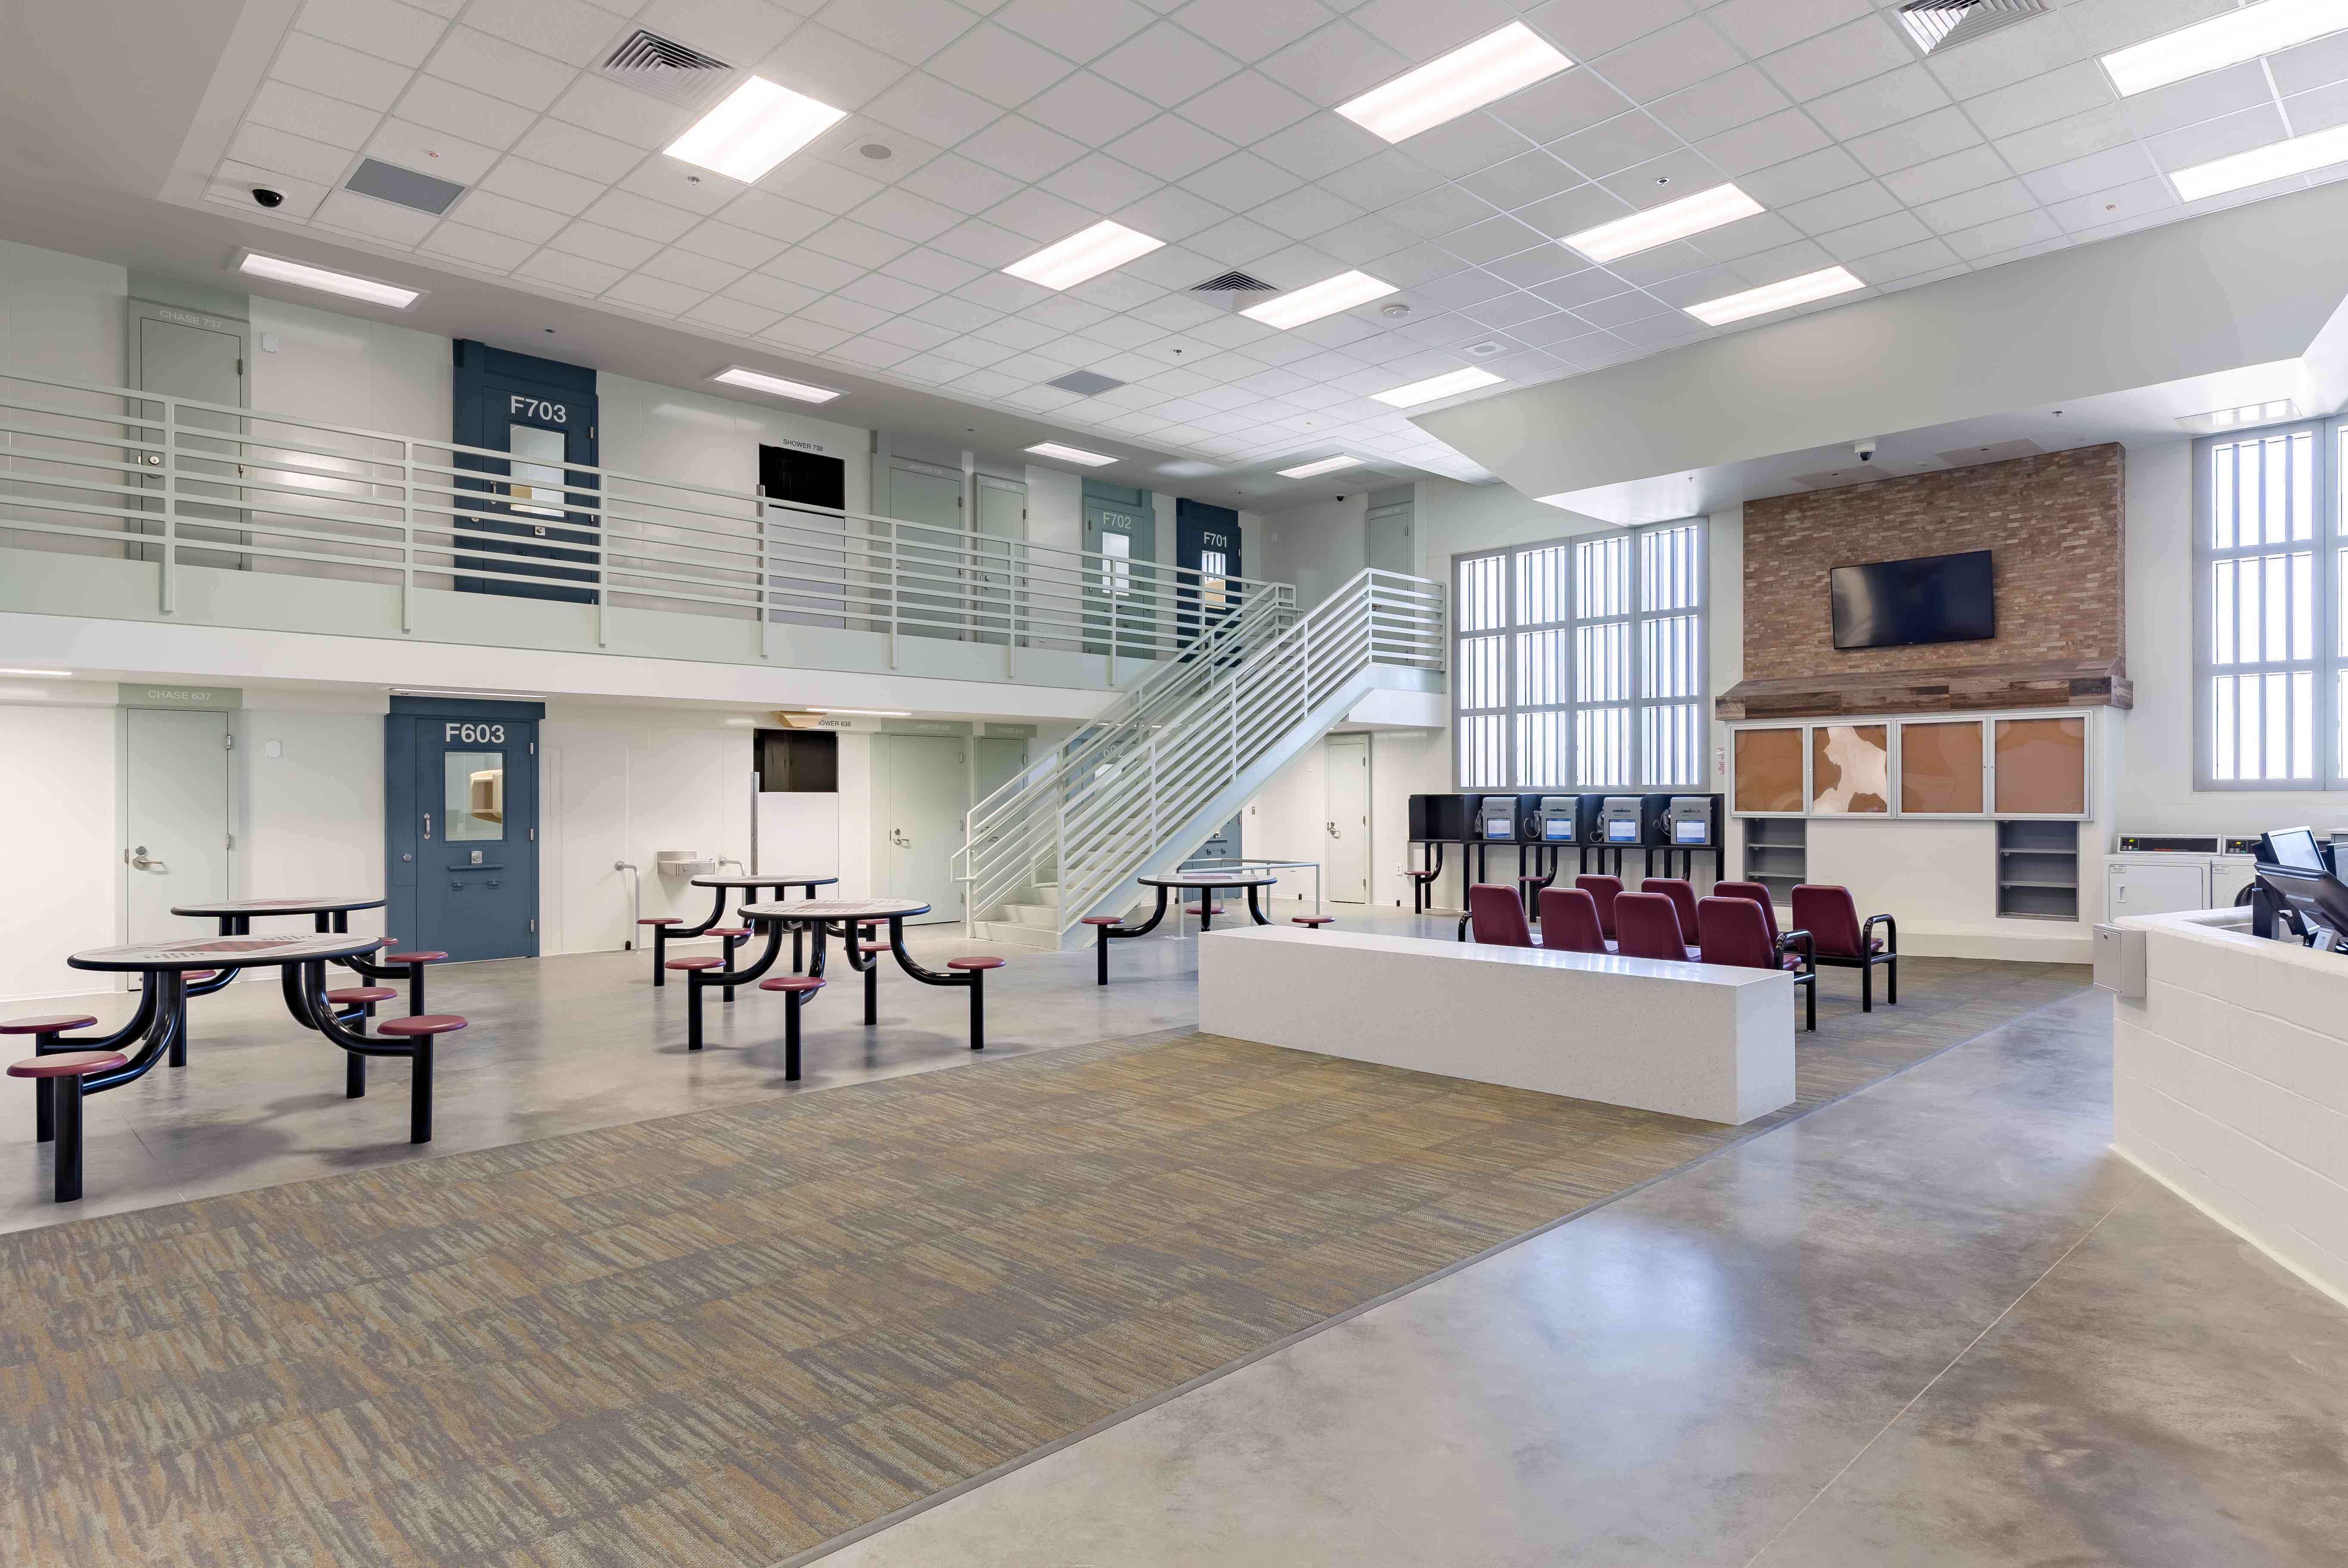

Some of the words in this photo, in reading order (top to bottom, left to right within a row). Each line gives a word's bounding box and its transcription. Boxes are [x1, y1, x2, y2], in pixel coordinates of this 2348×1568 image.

[160, 310, 200, 324] CHASE
[203, 318, 222, 329] 737
[511, 395, 566, 423] F703
[783, 439, 811, 449] SHOWER
[909, 463, 932, 473] JANITOR
[1103, 511, 1131, 530] F702
[1204, 532, 1227, 548] F701
[148, 690, 189, 699] CHASE
[192, 692, 211, 700] 637
[446, 723, 505, 743] F603
